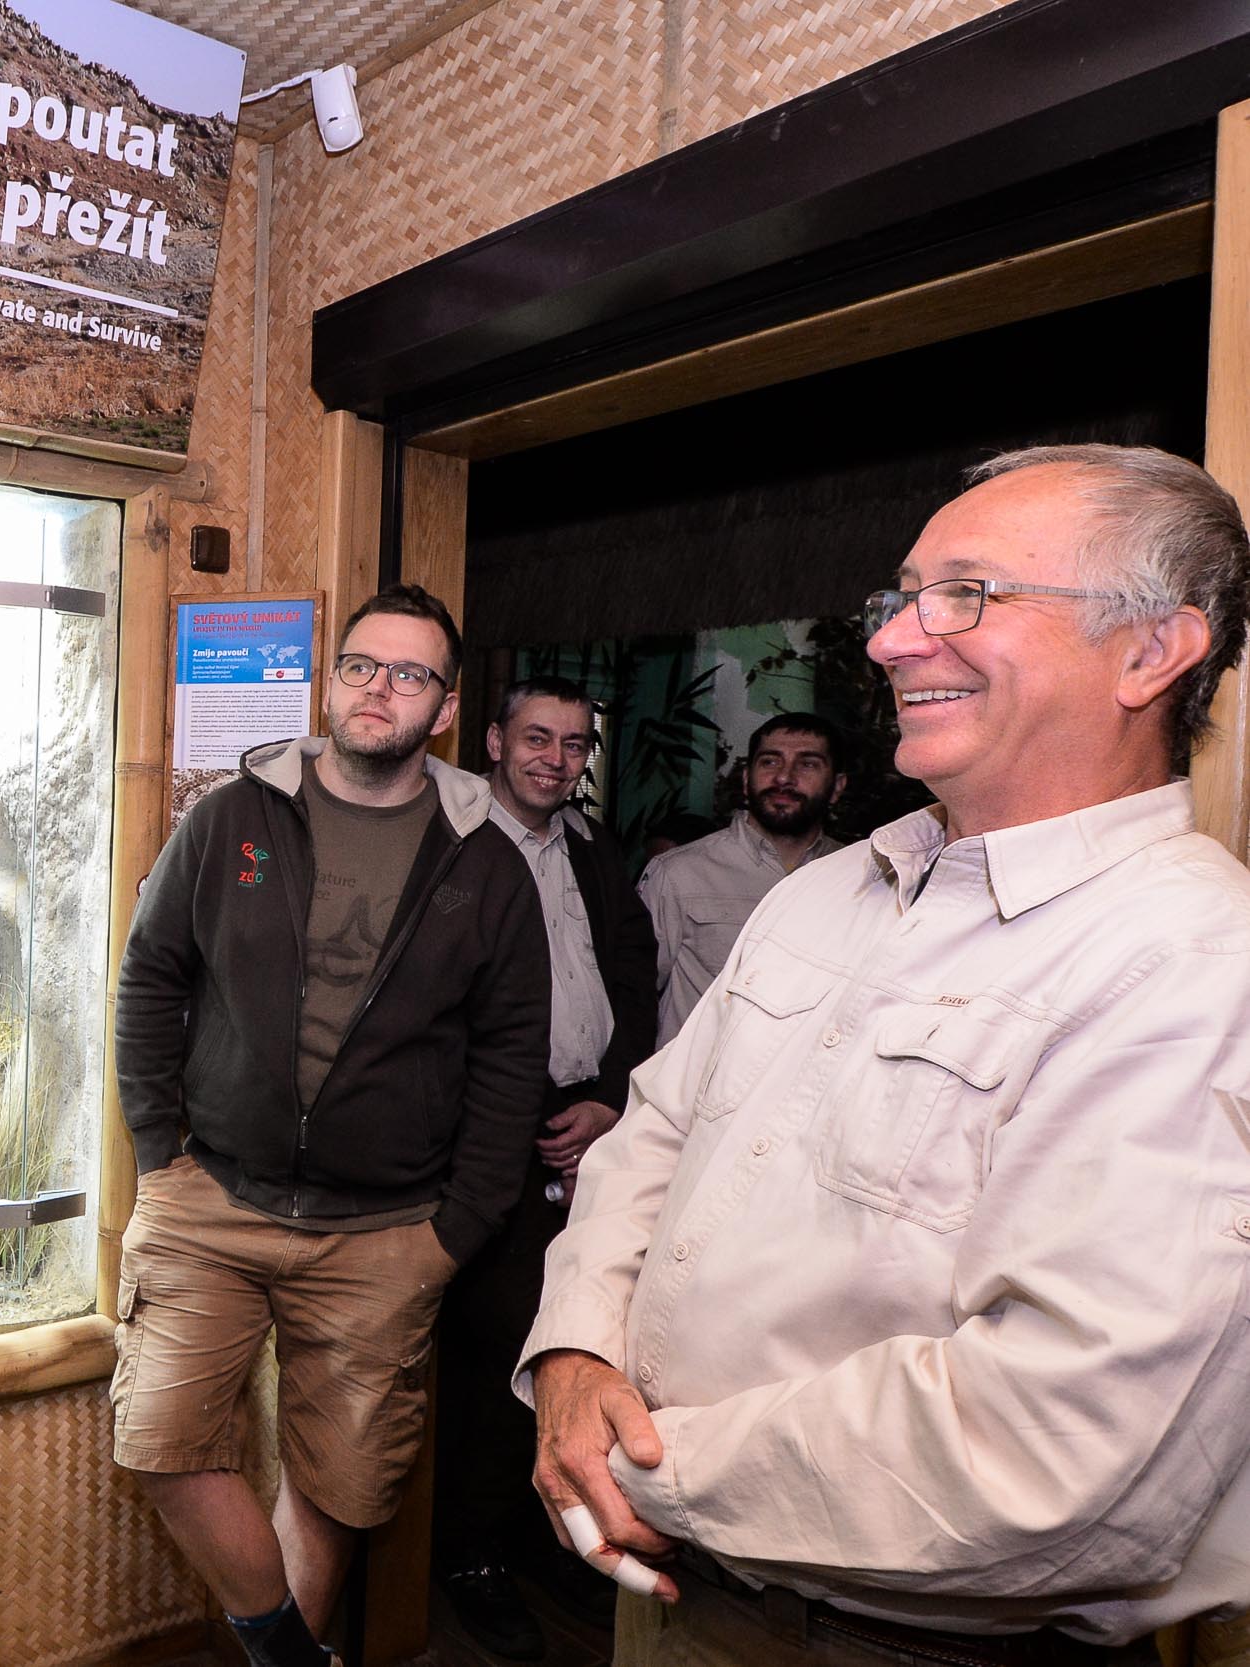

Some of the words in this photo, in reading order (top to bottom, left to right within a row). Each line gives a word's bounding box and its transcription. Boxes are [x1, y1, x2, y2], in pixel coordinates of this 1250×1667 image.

[0, 171, 170, 266] přežít
[42, 310, 83, 334] and
[88, 317, 162, 352] Survive
[193, 611, 248, 625] SVĚTOVÝ
[192, 648, 216, 659] Zmije
[217, 647, 249, 659] pavoučí
